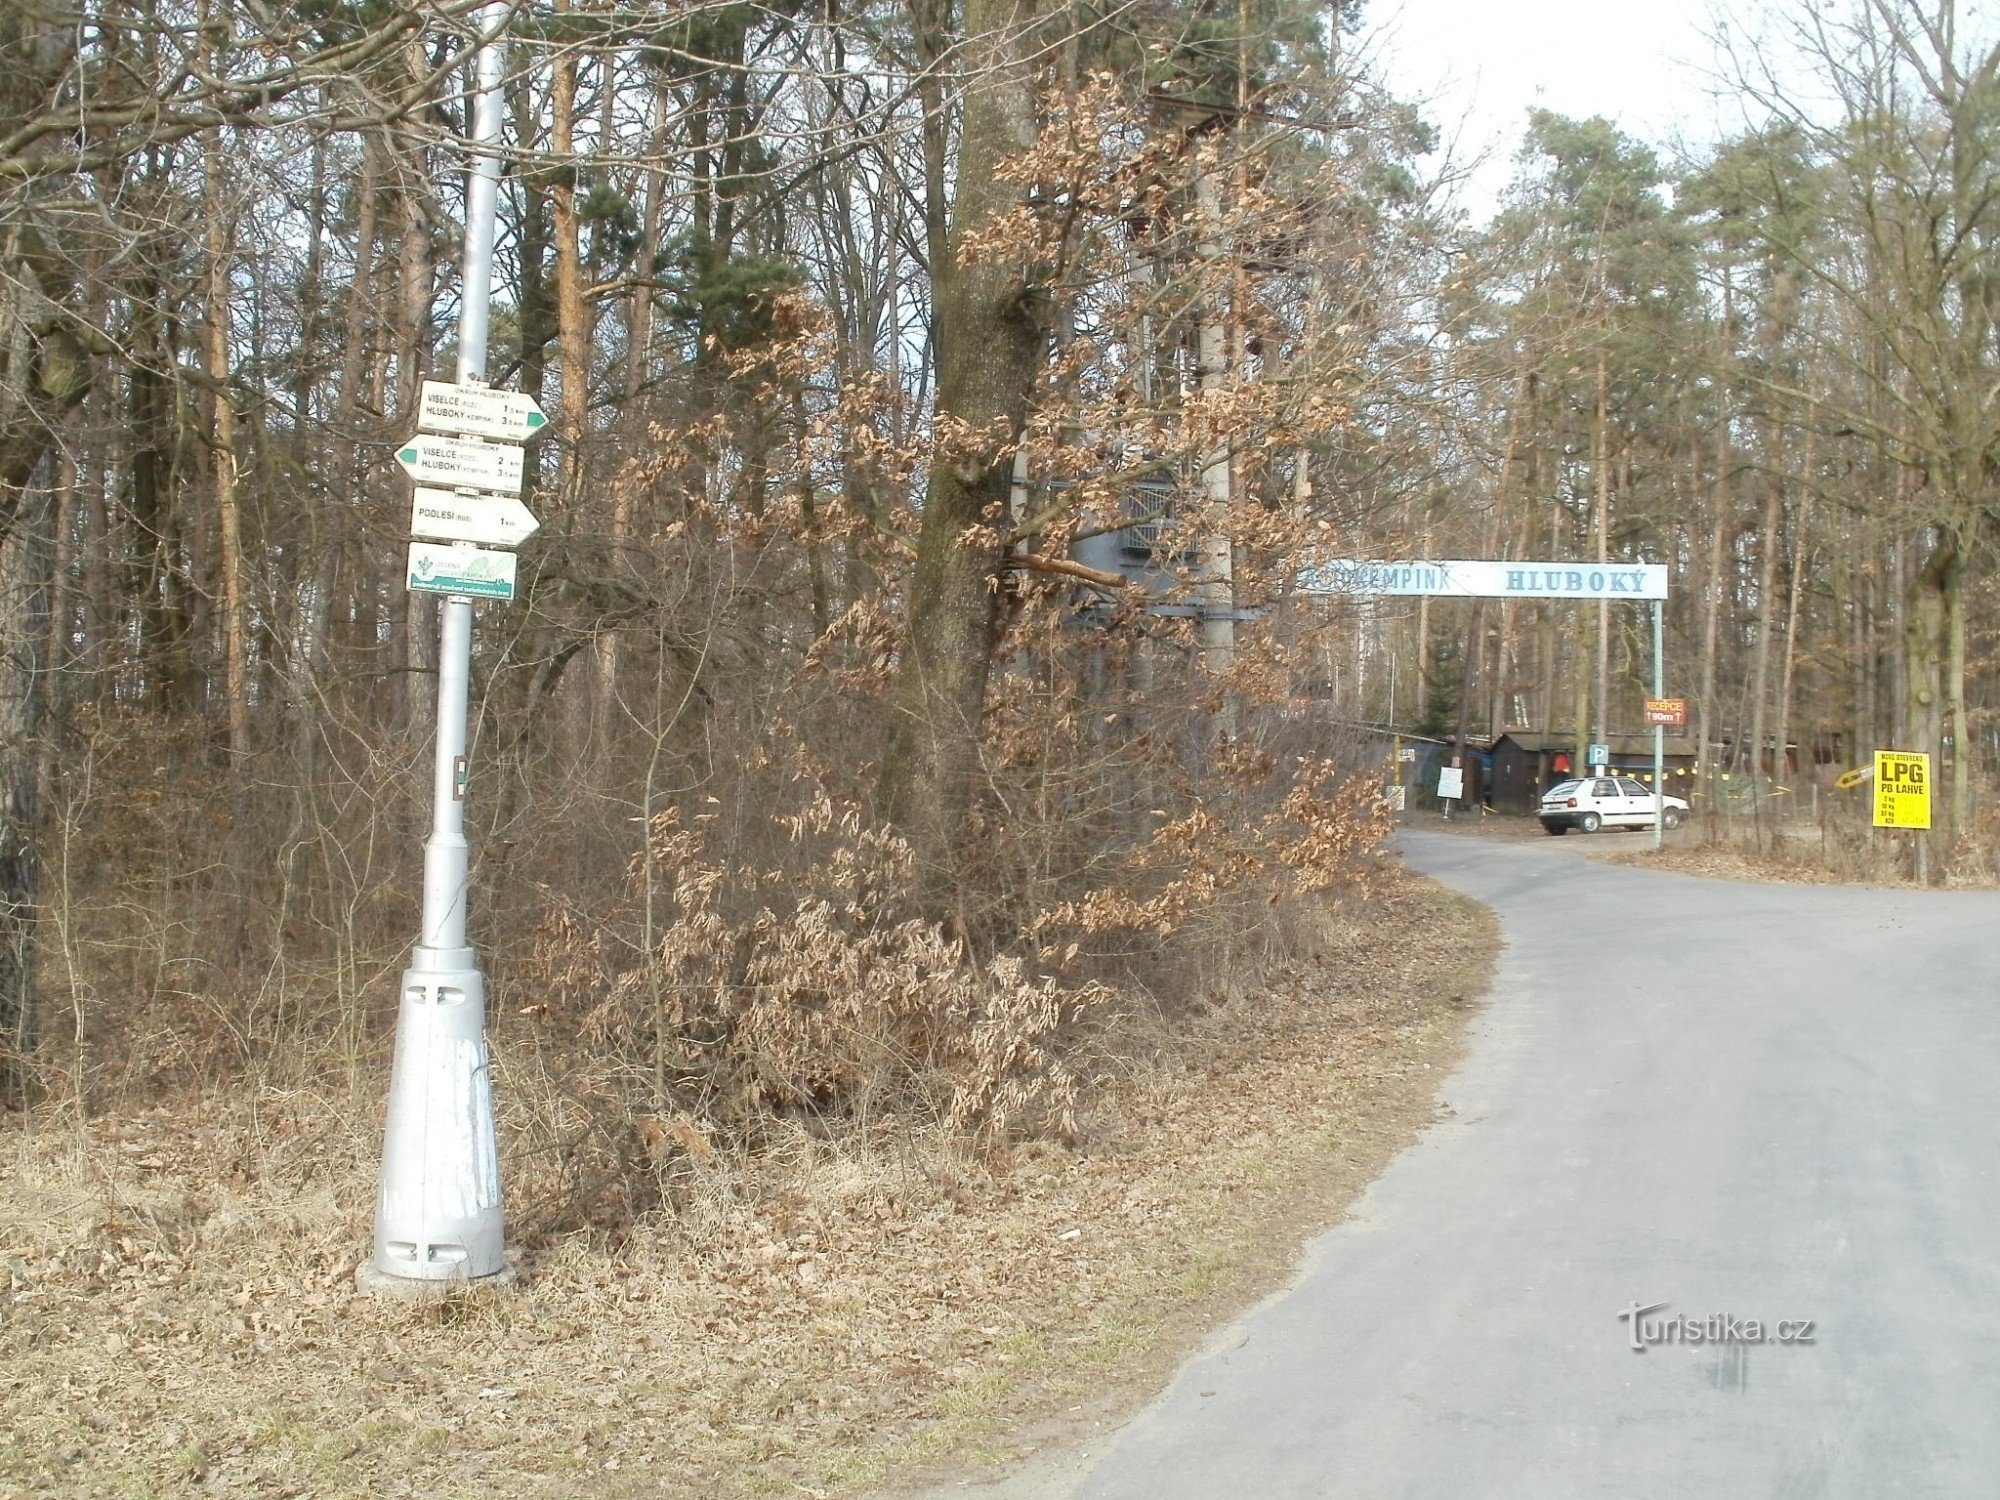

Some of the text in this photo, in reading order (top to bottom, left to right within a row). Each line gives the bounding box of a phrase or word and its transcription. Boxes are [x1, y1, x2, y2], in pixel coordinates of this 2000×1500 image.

[428, 394, 459, 406] VISELCE
[423, 447, 457, 459] VISELCE
[498, 456, 504, 464] 2
[1506, 569, 1646, 592] HLUBOKÝ
[1595, 748, 1603, 763] P
[1882, 762, 1923, 783] LPG
[1881, 784, 1893, 792] PB
